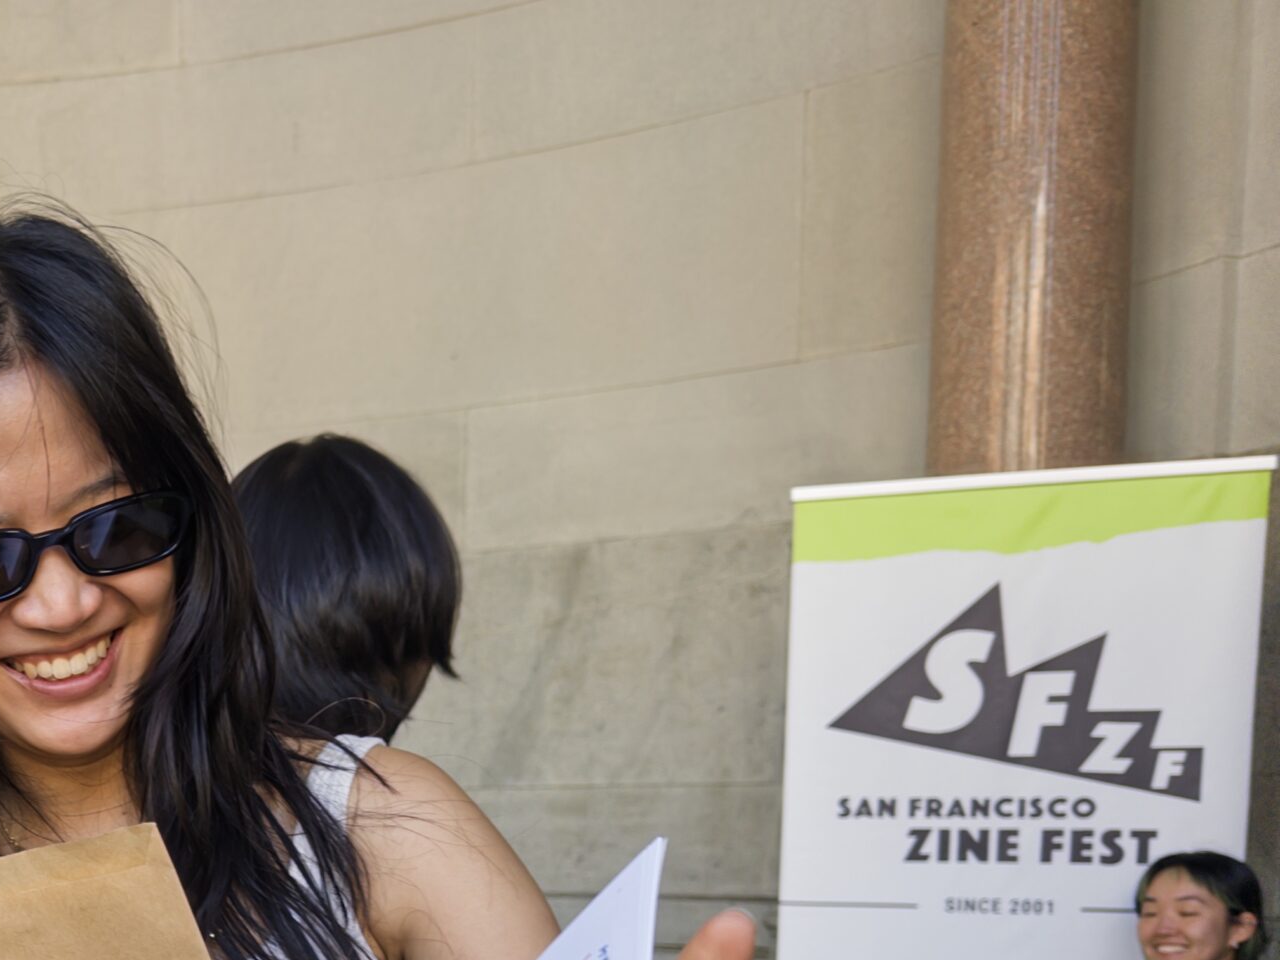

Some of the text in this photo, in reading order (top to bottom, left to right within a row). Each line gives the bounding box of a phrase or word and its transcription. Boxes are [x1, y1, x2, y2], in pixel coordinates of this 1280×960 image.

[837, 798, 1097, 820] SAN FRANCISCO
[904, 828, 1158, 865] ZINE FEST
[944, 898, 1055, 916] SINCE 2001
